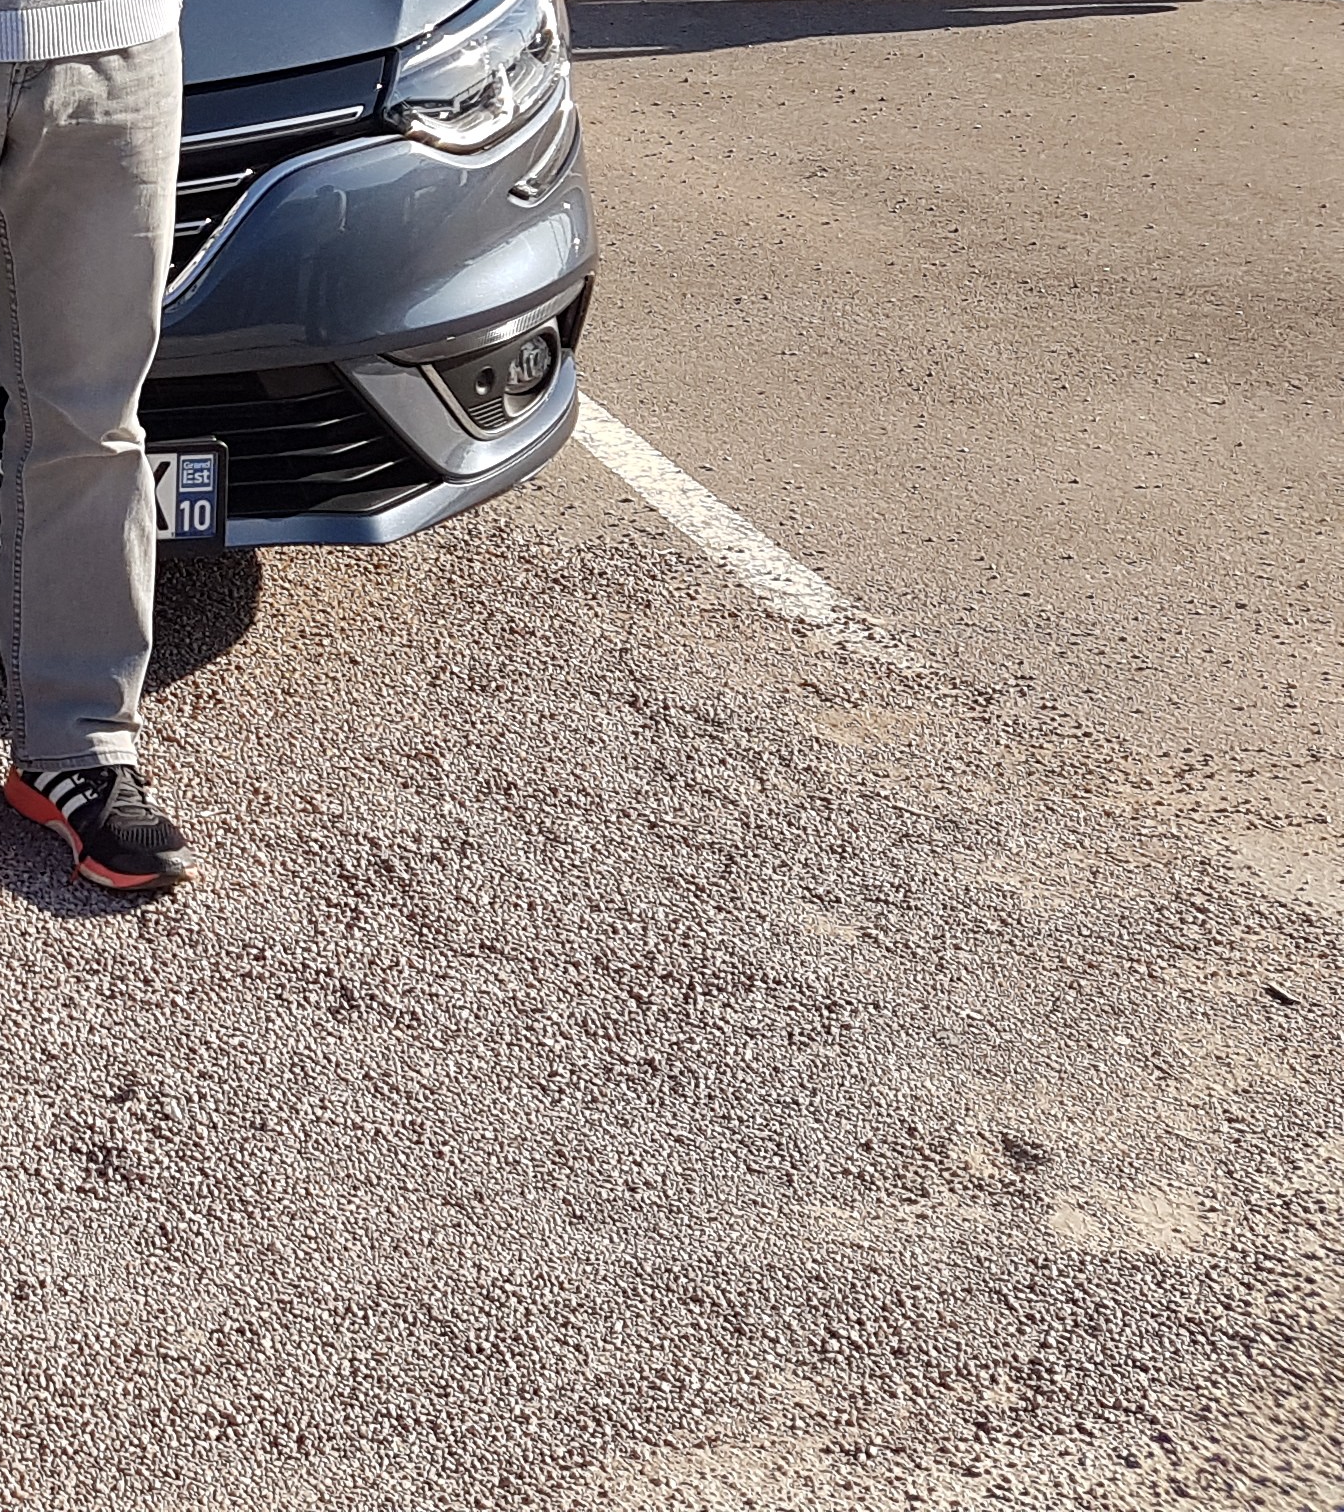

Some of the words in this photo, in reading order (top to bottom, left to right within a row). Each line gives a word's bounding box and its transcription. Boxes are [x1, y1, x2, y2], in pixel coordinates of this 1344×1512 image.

[183, 460, 211, 469] Grand
[182, 470, 210, 484] Est
[179, 499, 211, 532] 10
